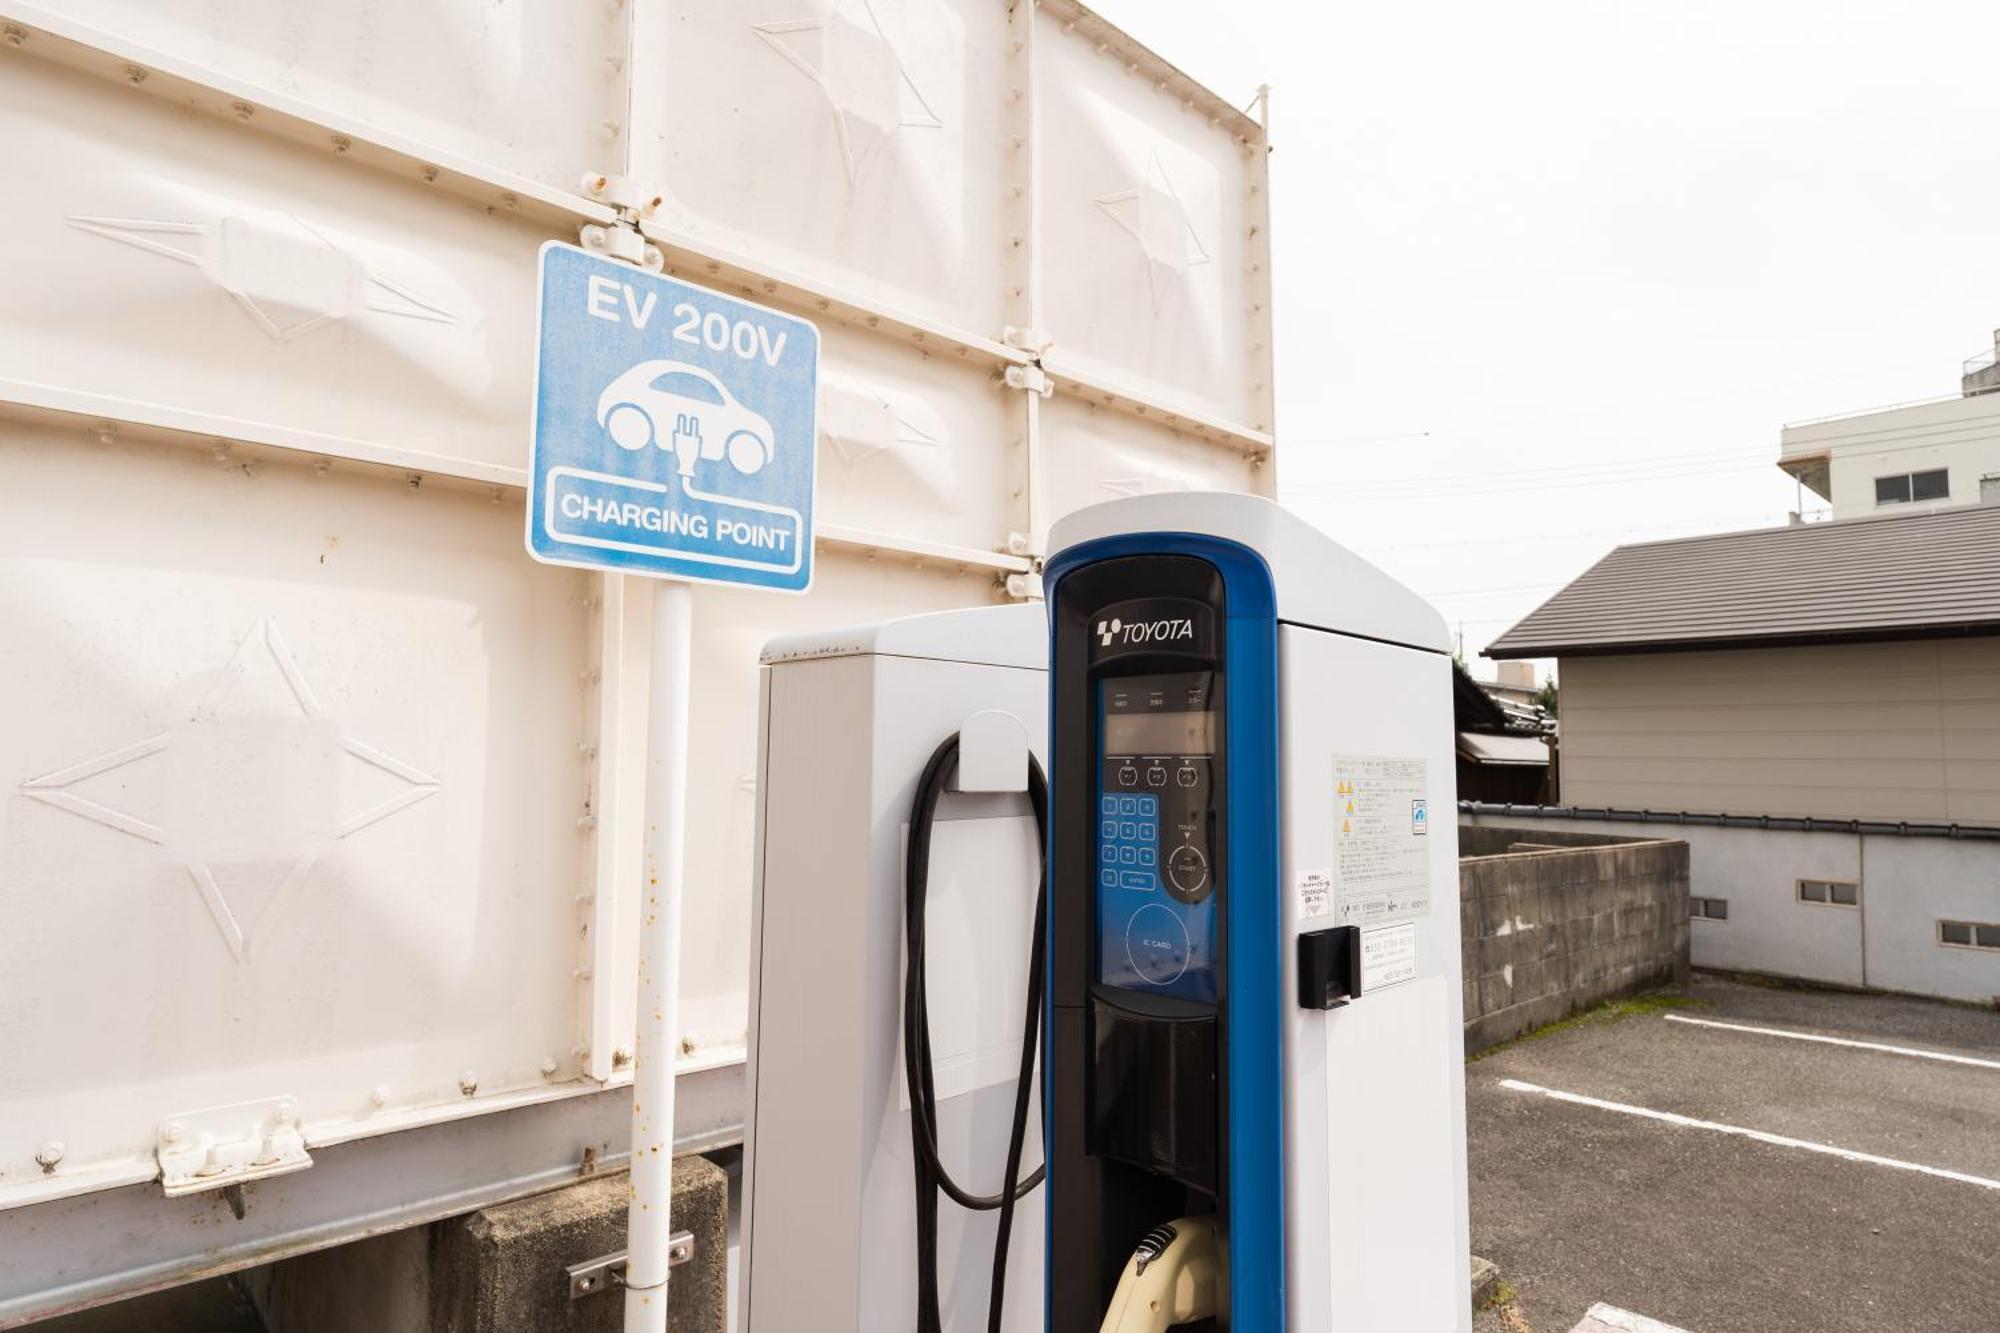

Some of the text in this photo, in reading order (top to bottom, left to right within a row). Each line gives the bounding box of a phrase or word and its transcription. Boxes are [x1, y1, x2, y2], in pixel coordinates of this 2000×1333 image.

[587, 274, 787, 367] EV 200V
[561, 493, 791, 552] CHARGING POINT
[1123, 619, 1193, 644] TOYOTA
[1151, 940, 1172, 949] CARD
